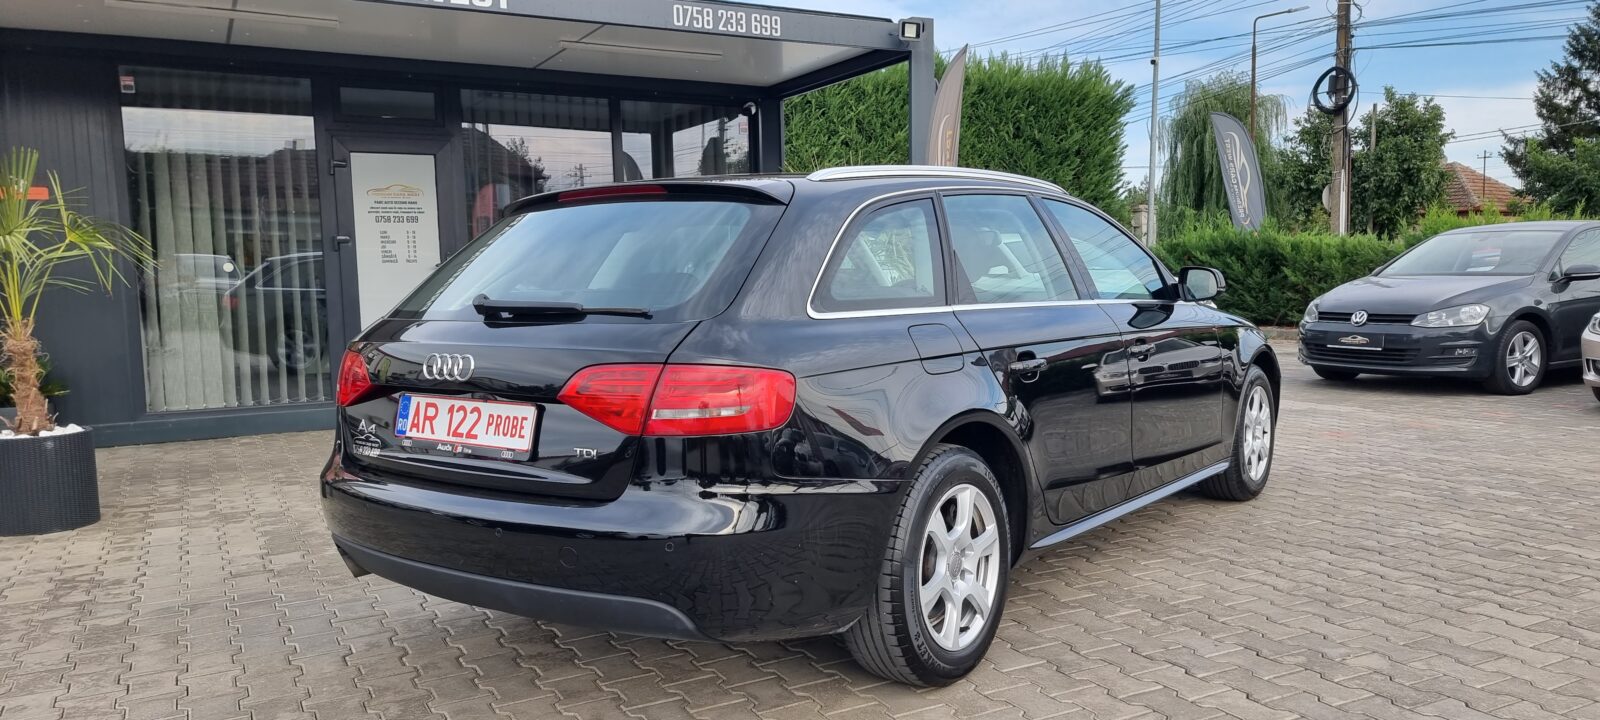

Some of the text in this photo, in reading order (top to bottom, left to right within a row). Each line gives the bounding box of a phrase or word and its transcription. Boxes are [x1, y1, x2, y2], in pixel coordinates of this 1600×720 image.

[673, 4, 781, 37] 0758 233 699
[375, 215, 419, 223] 0758 233 699
[357, 419, 377, 434] A4
[397, 417, 408, 431] RO
[409, 401, 529, 440] AR 122 PROBE
[436, 443, 452, 452] Audi
[573, 447, 597, 460] TDI
